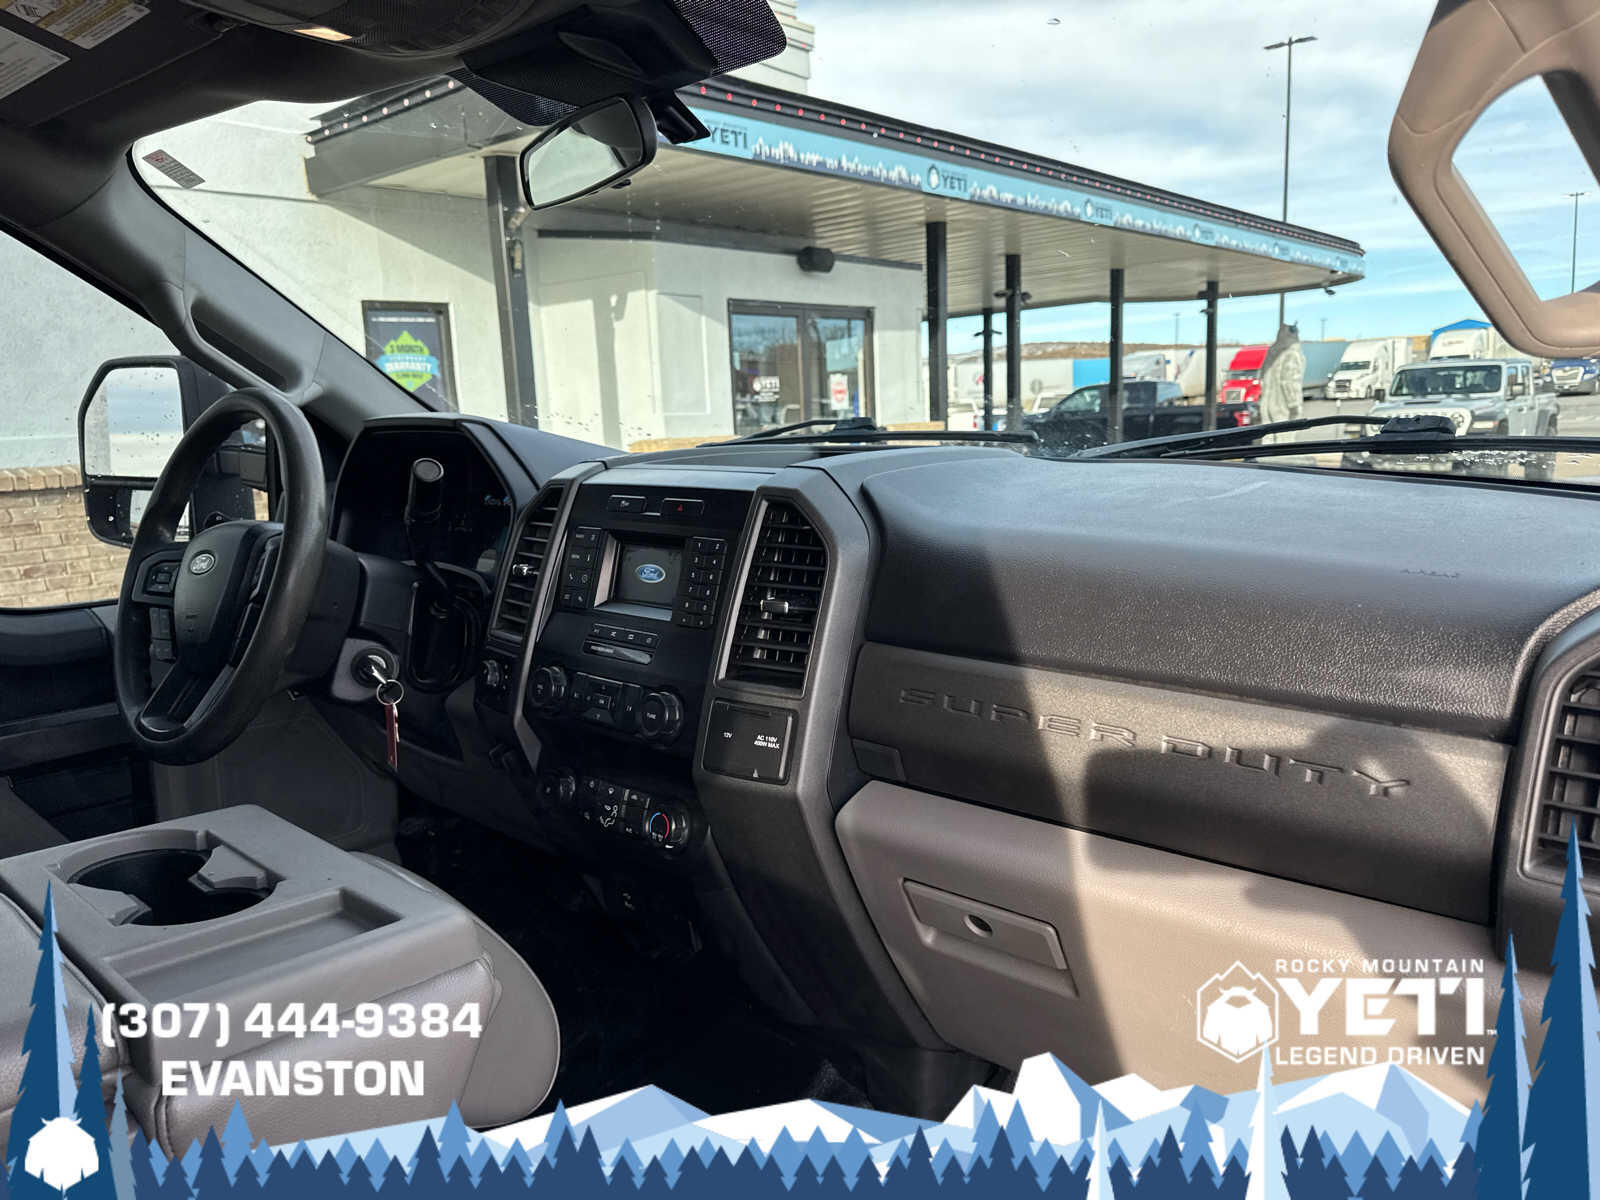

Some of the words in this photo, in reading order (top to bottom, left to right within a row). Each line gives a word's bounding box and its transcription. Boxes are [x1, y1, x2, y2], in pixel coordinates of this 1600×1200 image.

[707, 125, 748, 149] YETI
[901, 687, 1137, 748] SUPER
[1161, 734, 1410, 798] DUTY
